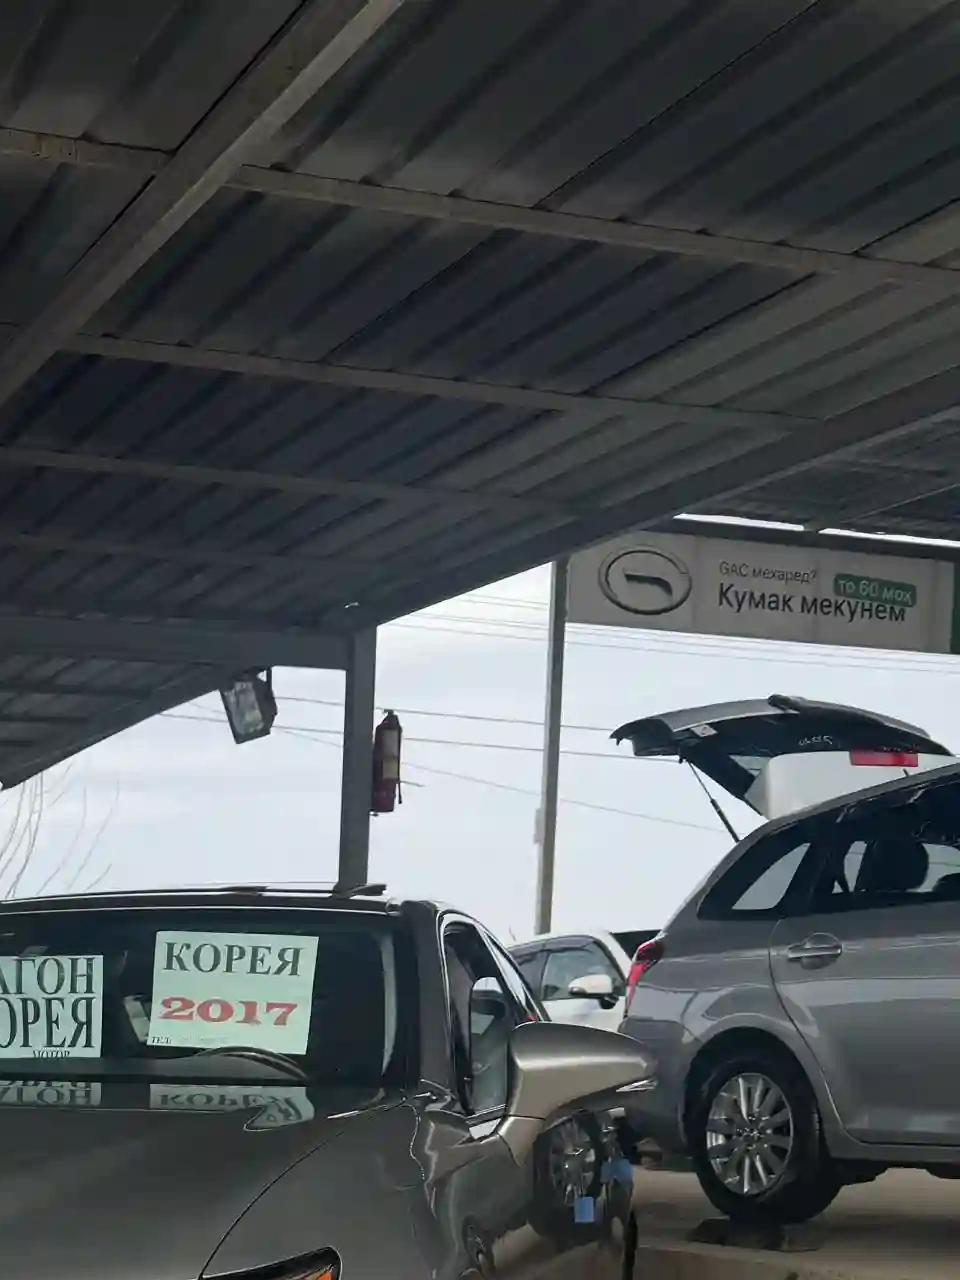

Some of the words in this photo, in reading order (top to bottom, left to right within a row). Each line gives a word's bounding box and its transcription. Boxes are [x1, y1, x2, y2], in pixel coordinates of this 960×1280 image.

[719, 561, 749, 577] GAC
[752, 566, 818, 585] мехаред?
[718, 583, 794, 613] Кумак
[800, 597, 907, 623] мекунем
[859, 580, 878, 597] 60
[163, 942, 305, 977] КОРЕЯ
[158, 996, 298, 1026] 2017
